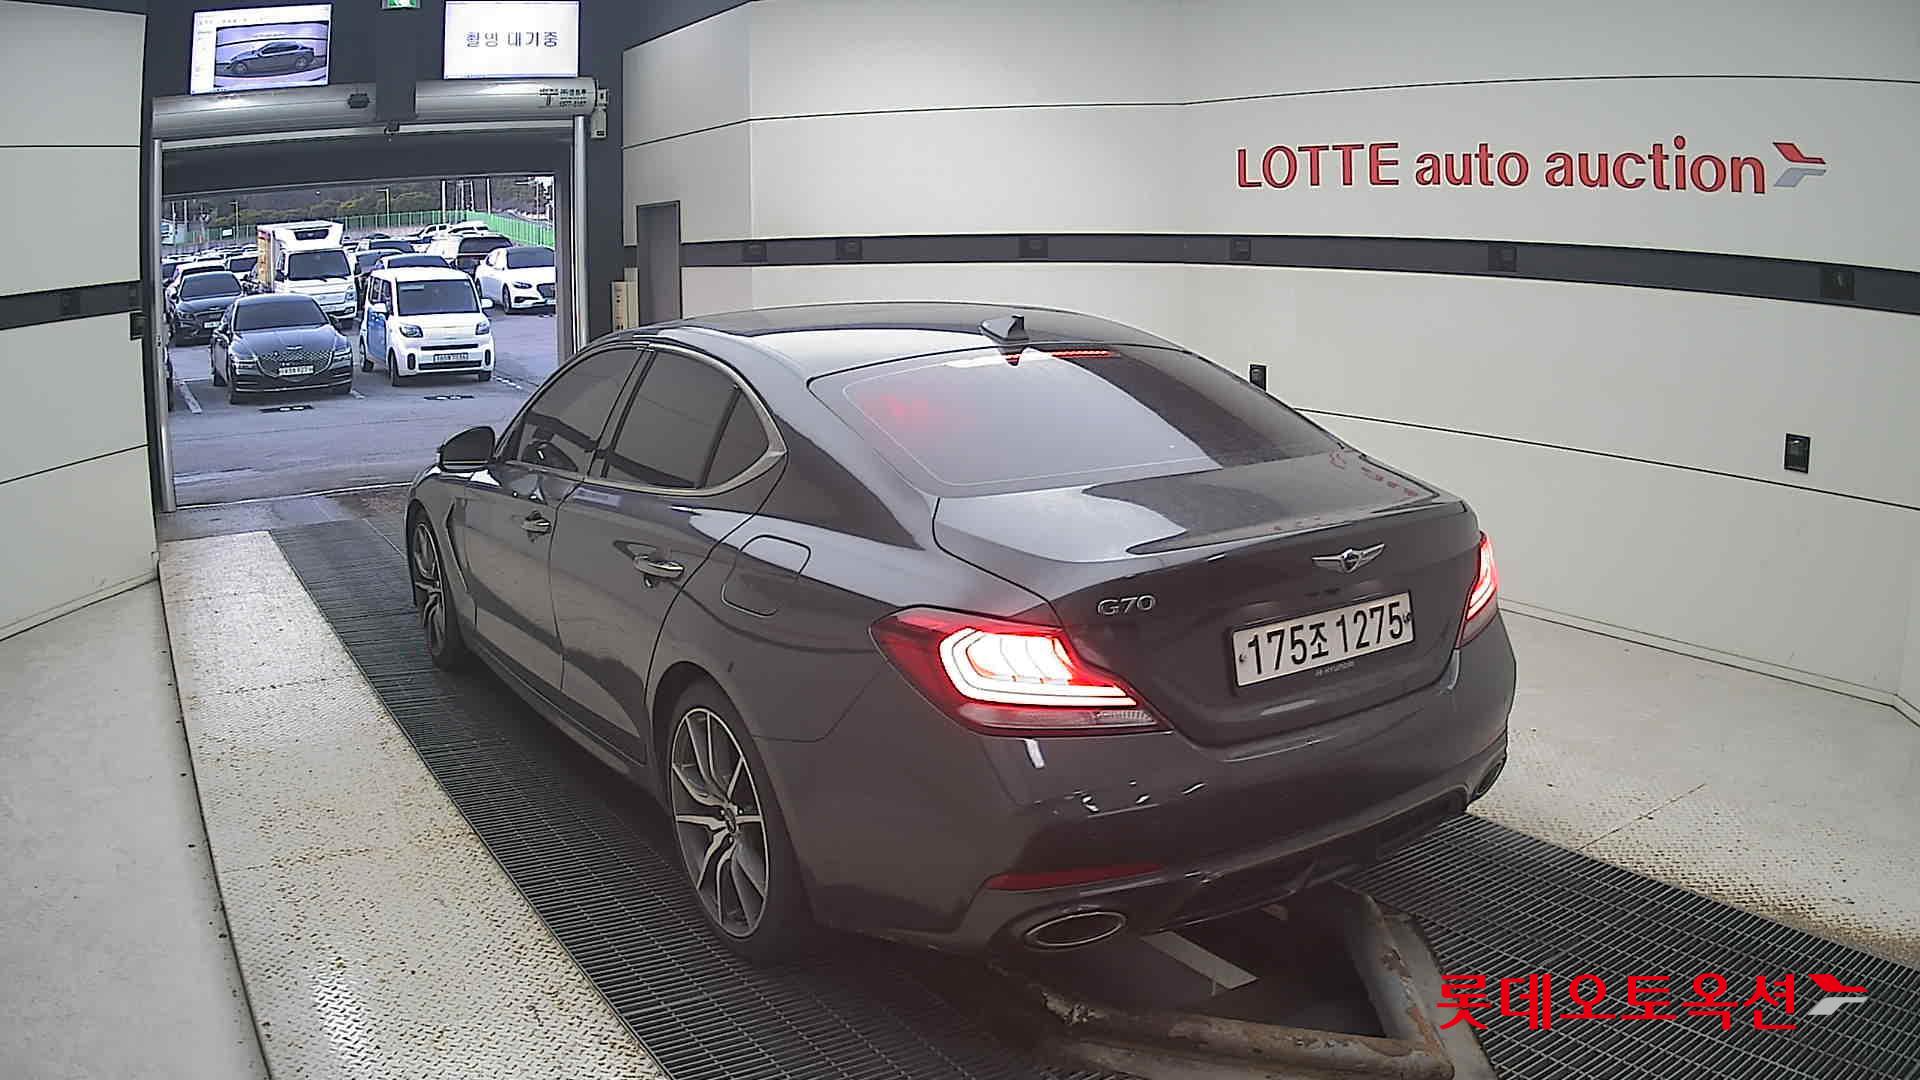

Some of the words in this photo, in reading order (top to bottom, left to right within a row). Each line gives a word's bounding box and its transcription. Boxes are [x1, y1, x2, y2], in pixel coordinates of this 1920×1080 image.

[1237, 142, 1399, 189] LOTTE
[1415, 143, 1530, 188] auto
[1545, 135, 1766, 194] auction
[1097, 595, 1156, 616] G70
[1247, 622, 1330, 675] 175조
[1335, 601, 1404, 653] 1275
